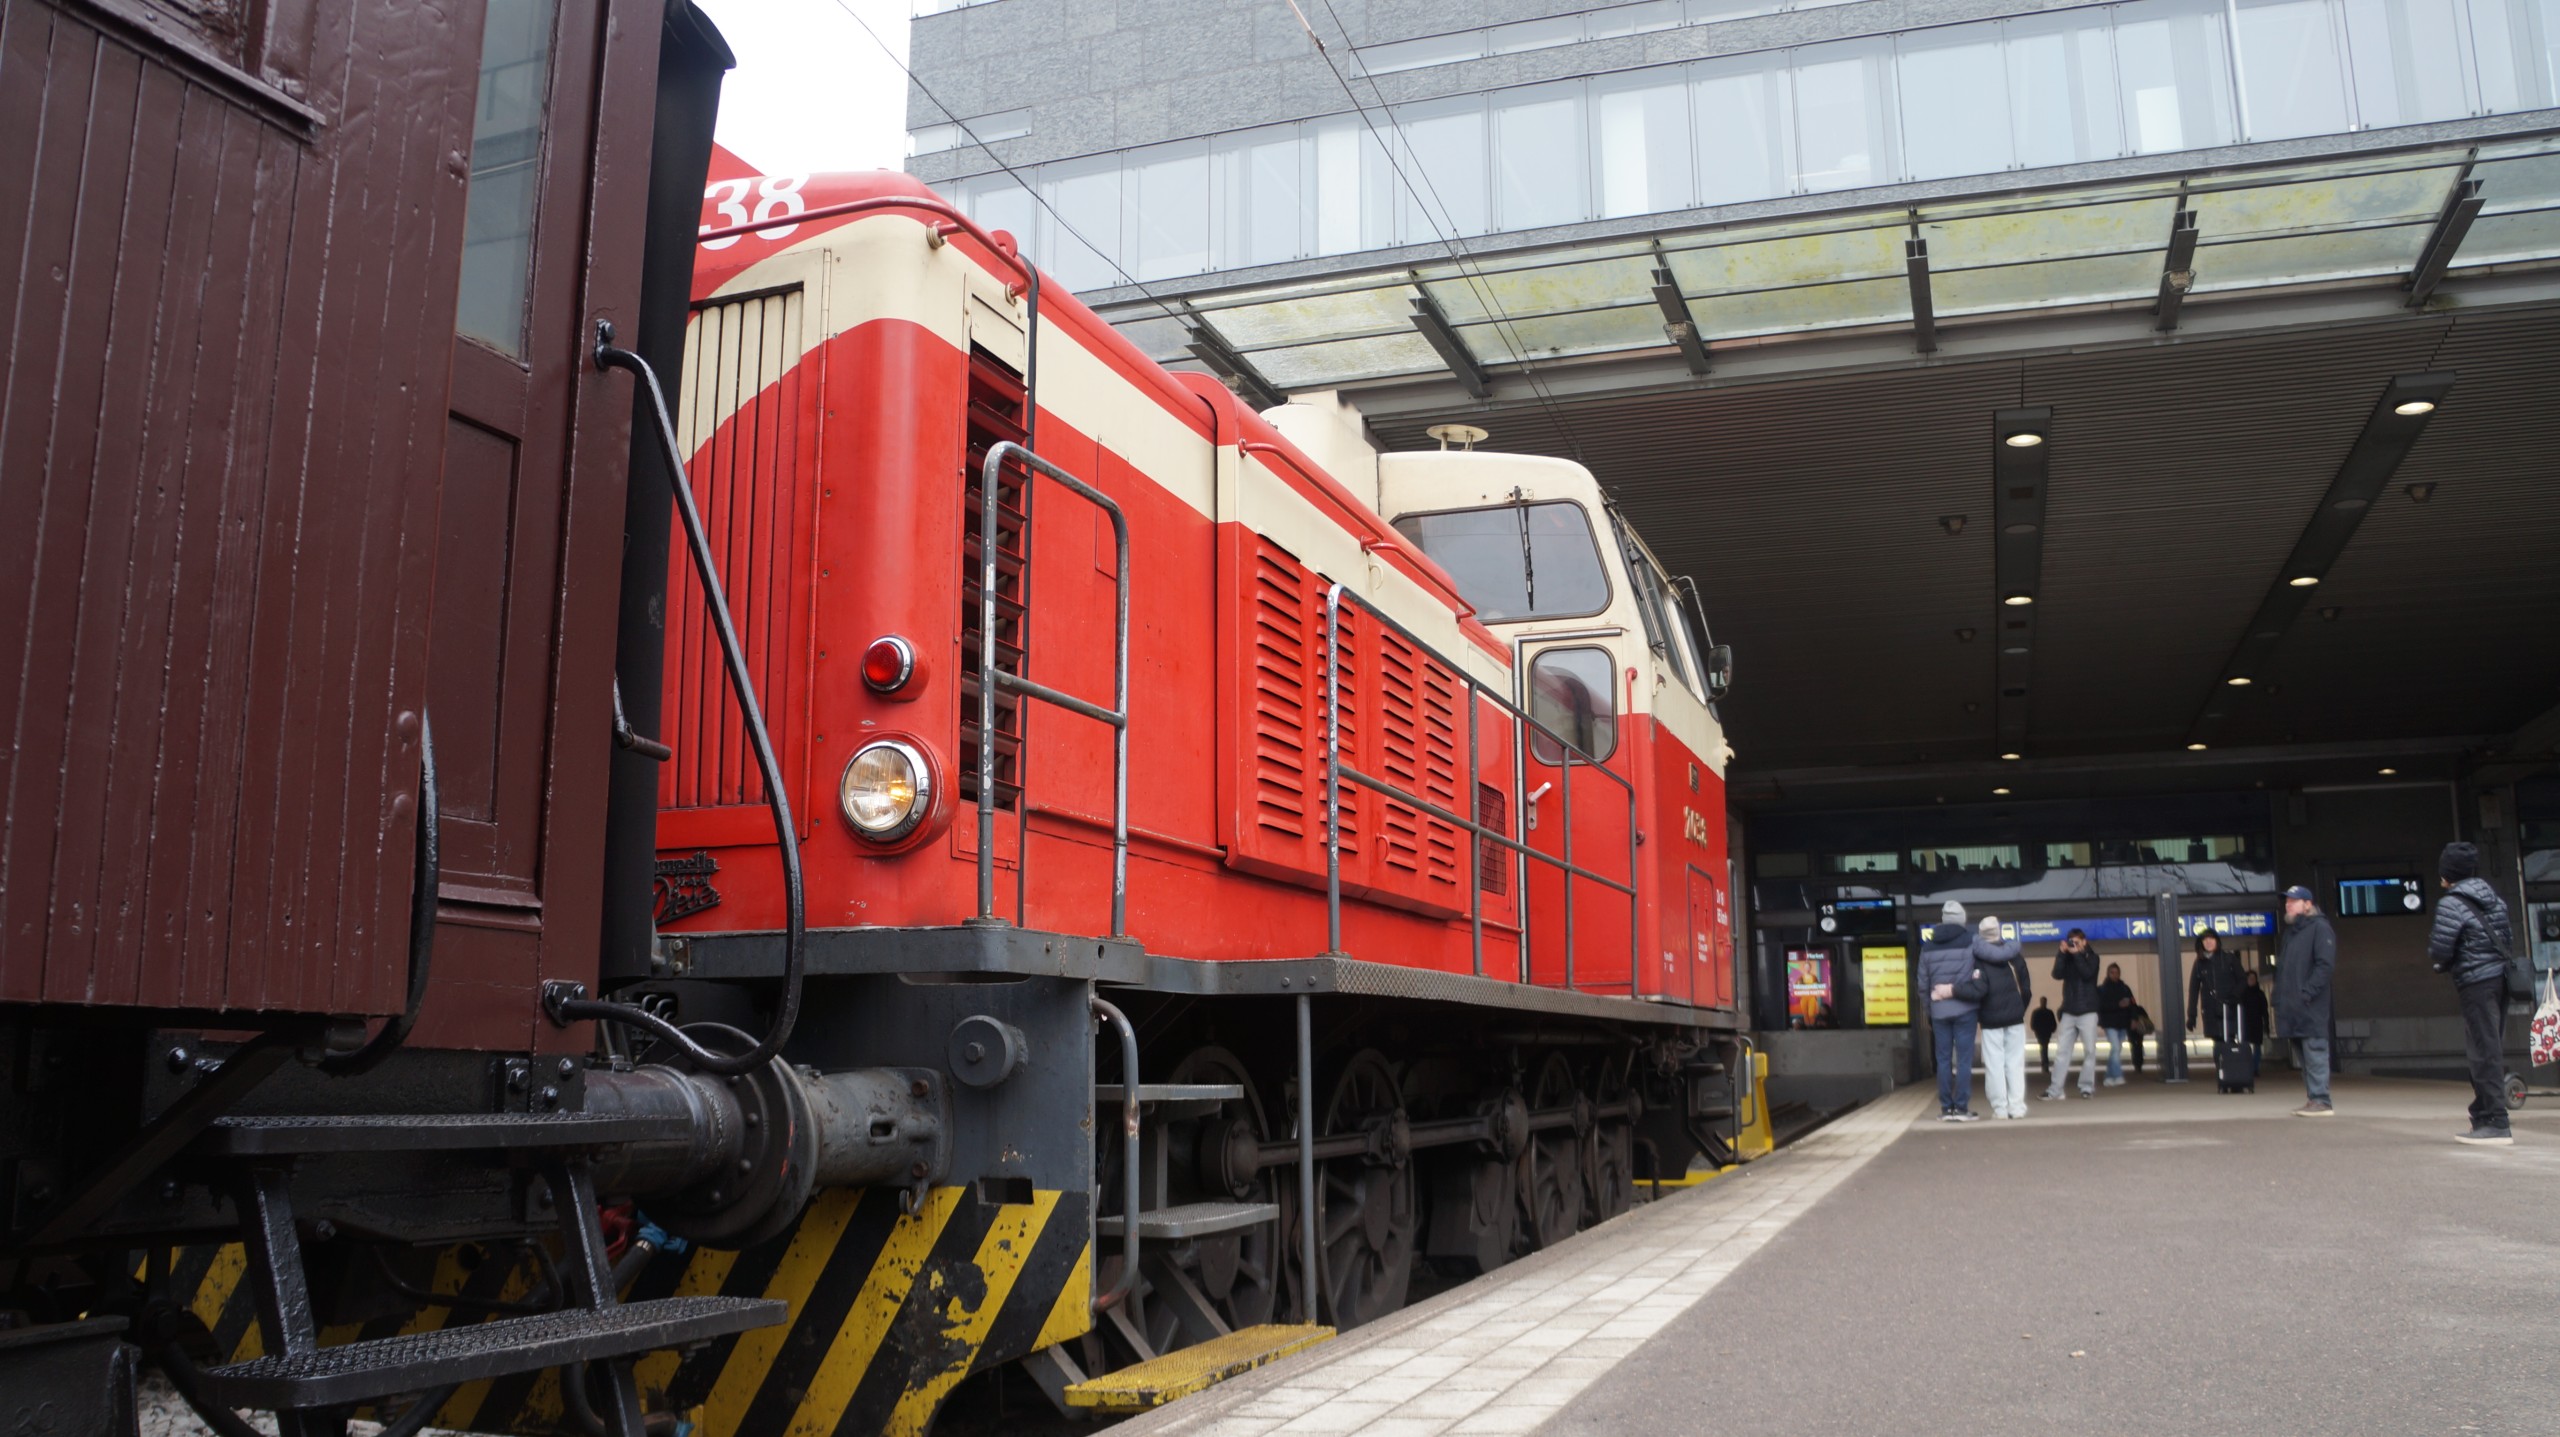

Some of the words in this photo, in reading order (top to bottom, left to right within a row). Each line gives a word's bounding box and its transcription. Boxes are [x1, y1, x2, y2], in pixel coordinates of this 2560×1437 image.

[700, 173, 810, 250] 38
[2403, 880, 2418, 891] 14
[1821, 904, 1834, 916] 13
